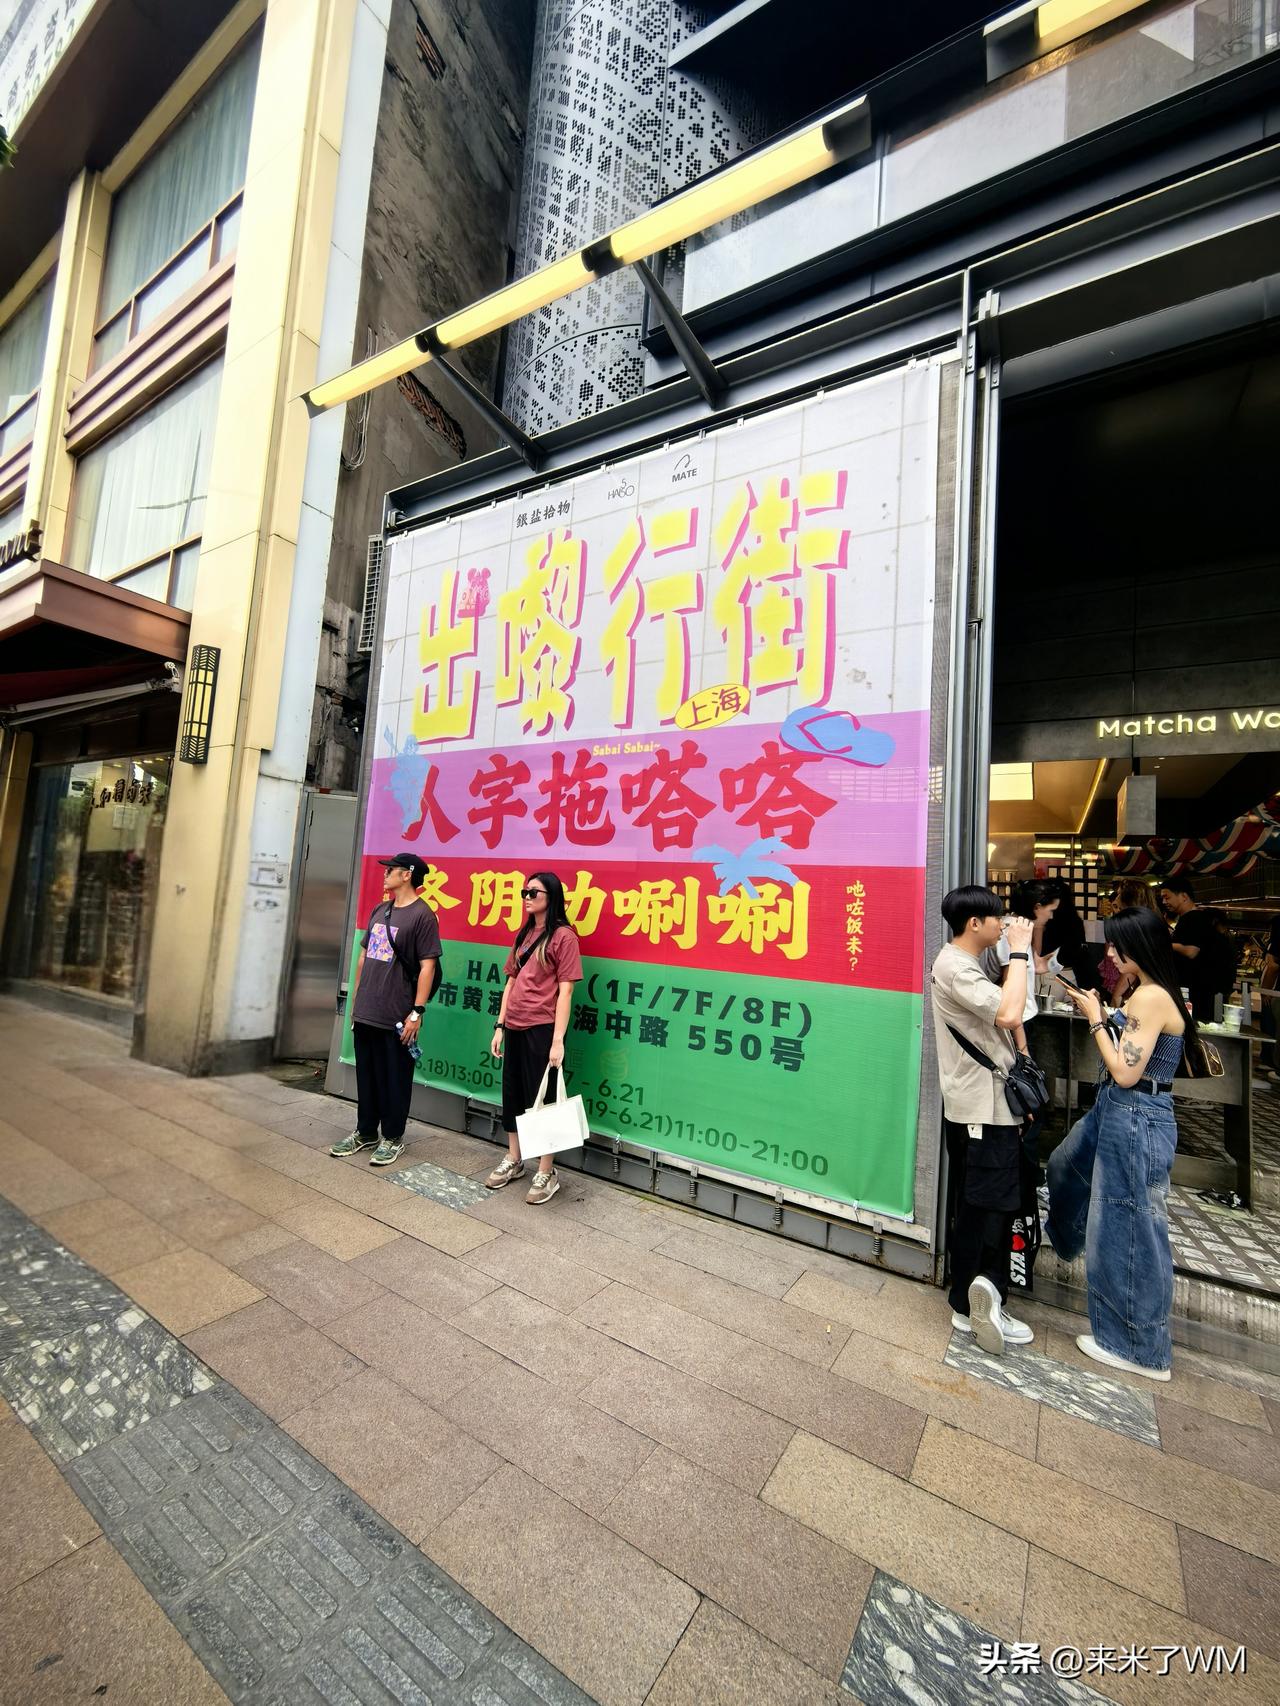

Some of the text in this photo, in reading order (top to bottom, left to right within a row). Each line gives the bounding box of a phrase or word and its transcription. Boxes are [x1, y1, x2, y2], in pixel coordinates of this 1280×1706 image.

[672, 469, 697, 483] MATE
[411, 470, 851, 746] 出嚟行街
[685, 686, 741, 728] 上海
[1099, 714, 1217, 738] Matcha
[593, 744, 621, 756] Sabai
[688, 1024, 805, 1072] 550号
[598, 1079, 644, 1106] 6.21
[585, 1098, 829, 1176] 19-6.21)11:00-21:00
